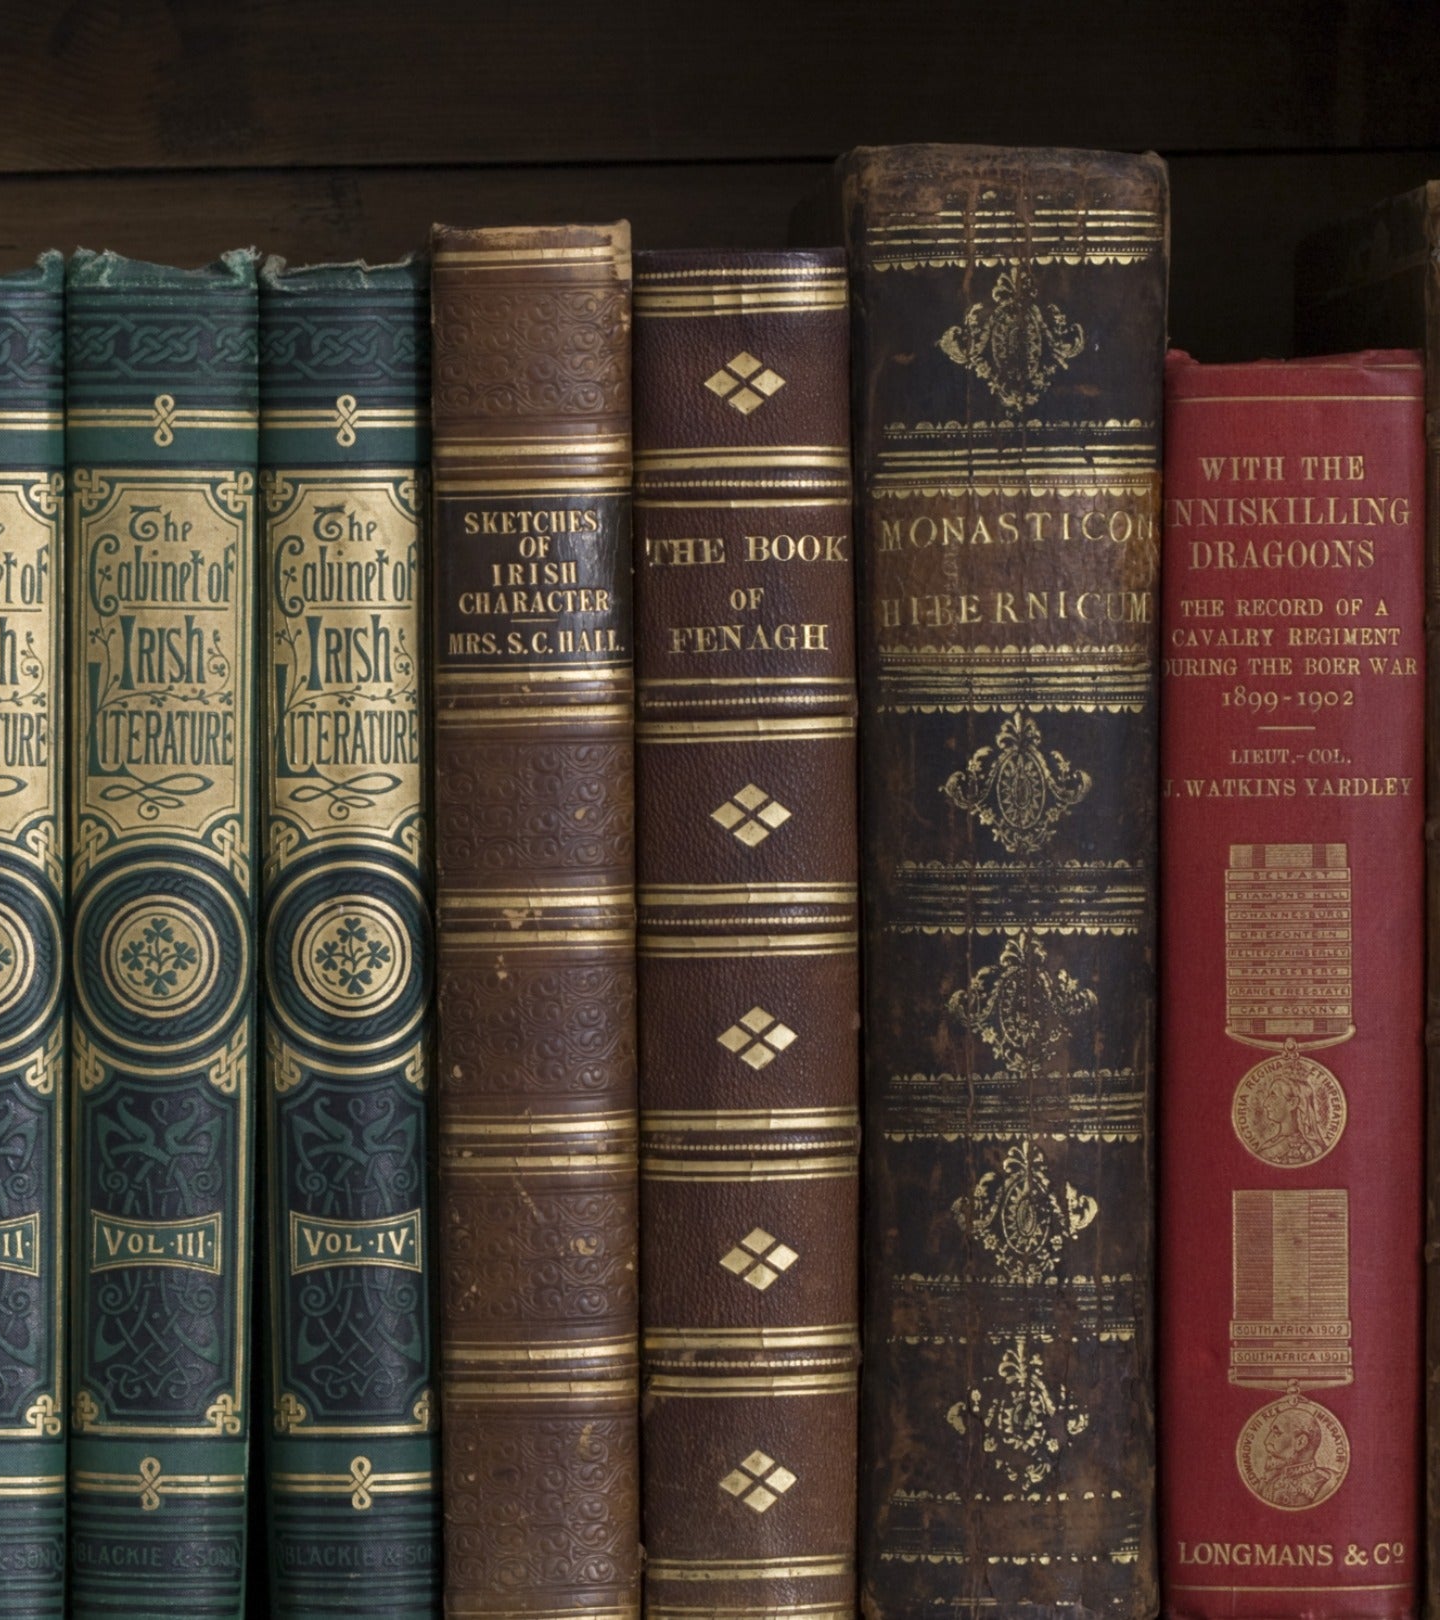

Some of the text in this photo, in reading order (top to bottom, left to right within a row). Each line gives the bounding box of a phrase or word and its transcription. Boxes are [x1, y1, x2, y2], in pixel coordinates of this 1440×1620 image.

[1198, 455, 1365, 481] WITH THE
[129, 505, 192, 542] The
[313, 505, 377, 541] The
[464, 510, 598, 535] SKETCHES
[880, 511, 1152, 551] MONASTICON
[519, 535, 550, 558] OF
[646, 535, 848, 566] THE BOOK
[1189, 540, 1375, 570] DRAGOONS
[20, 543, 49, 604] of
[89, 533, 236, 616] Cabinet of
[275, 535, 417, 617] Cabinet of
[492, 561, 578, 586] IRISH
[459, 589, 609, 614] CHARACTER
[730, 588, 764, 610] OF
[881, 592, 1151, 628] HIBERNICUM
[1181, 599, 1389, 616] THE RECORD OF A
[448, 630, 625, 655] MRS. S. C. HALL.
[668, 624, 828, 653] FENAGH
[1172, 628, 1400, 647] CAVALRY REGIMENT
[1248, 658, 1292, 675] THE
[1305, 658, 1360, 675] BOER
[1370, 659, 1417, 676] WAR
[1185, 779, 1297, 796] WATKINS
[1305, 777, 1413, 796] YARDLEY
[1253, 871, 1330, 881] BELFAST
[1235, 891, 1345, 900] DIAMOND HILL
[1231, 910, 1345, 919] JOHANNESBURG
[1240, 930, 1337, 939] DRIEFONTEIN
[1240, 968, 1339, 976] PAARDEBERG
[1240, 1005, 1338, 1015] CAPE COLONY
[1246, 1061, 1283, 1090] REGINA
[1238, 1094, 1260, 1149] VICTORIA
[1316, 1325, 1344, 1335] 1902
[1320, 1351, 1346, 1361] 1901
[1178, 1541, 1334, 1566] LONGMANS
[1344, 1543, 1368, 1566] &
